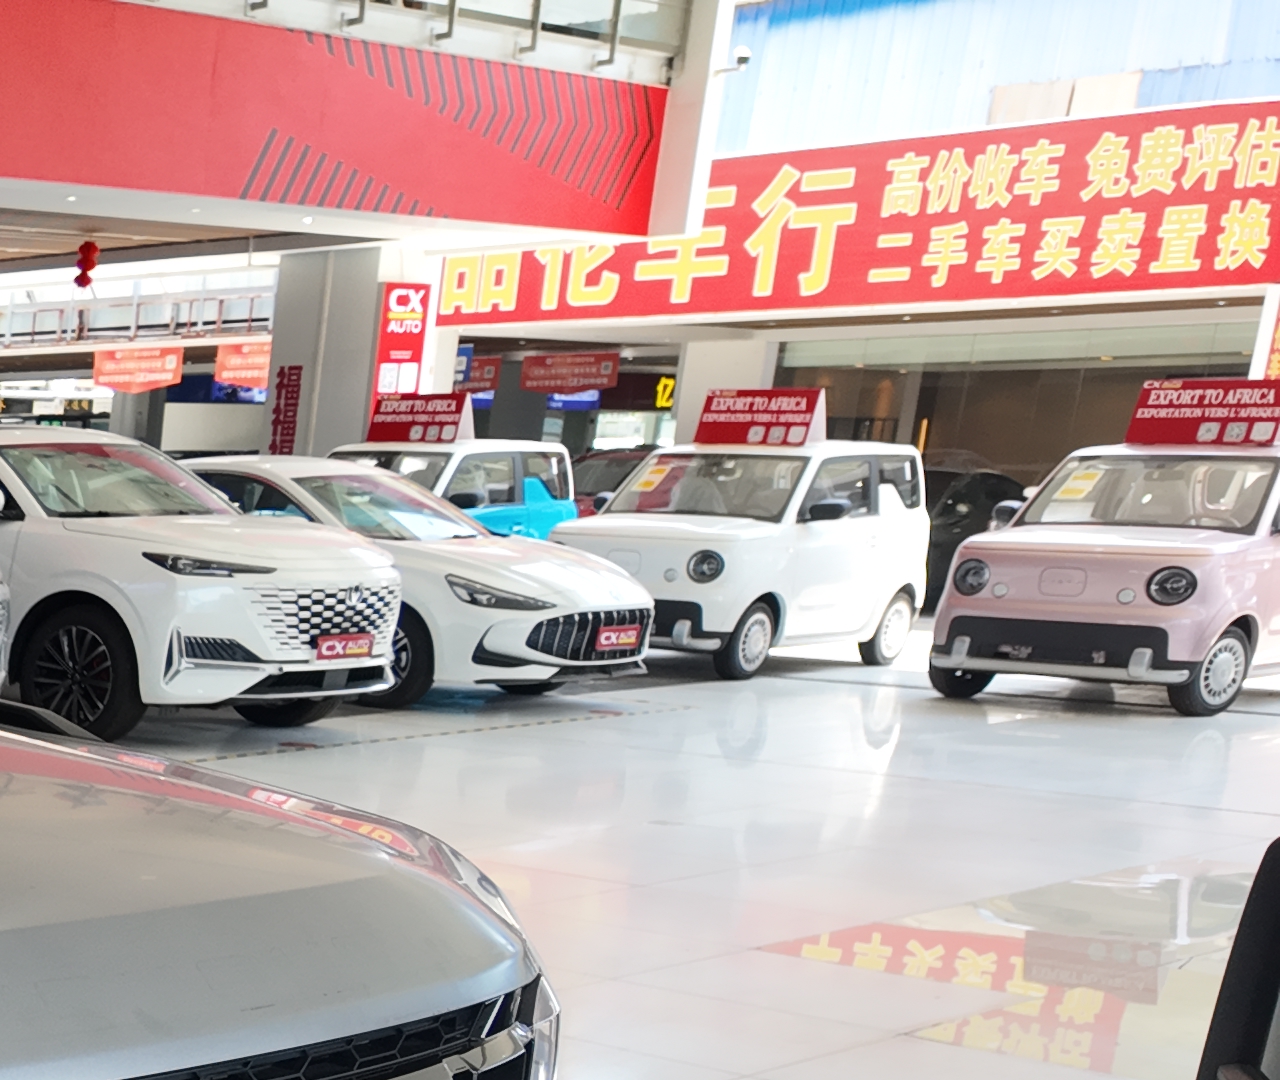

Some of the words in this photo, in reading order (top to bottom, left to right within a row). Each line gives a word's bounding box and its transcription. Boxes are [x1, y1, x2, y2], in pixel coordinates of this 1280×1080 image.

[879, 138, 1067, 218] 高价收车
[1078, 116, 1280, 203] 免费评估
[866, 197, 1272, 288] 二手车买卖置换
[388, 287, 427, 313] CX
[385, 318, 423, 334] AUTO
[710, 397, 753, 411] EXPORT
[752, 396, 769, 411] TO
[768, 395, 808, 411] AFRICA
[1146, 389, 1203, 406] EXPORT
[1203, 388, 1224, 405] TO
[1222, 388, 1276, 405] AFRICA
[600, 631, 620, 645] CX
[321, 639, 348, 656] CX
